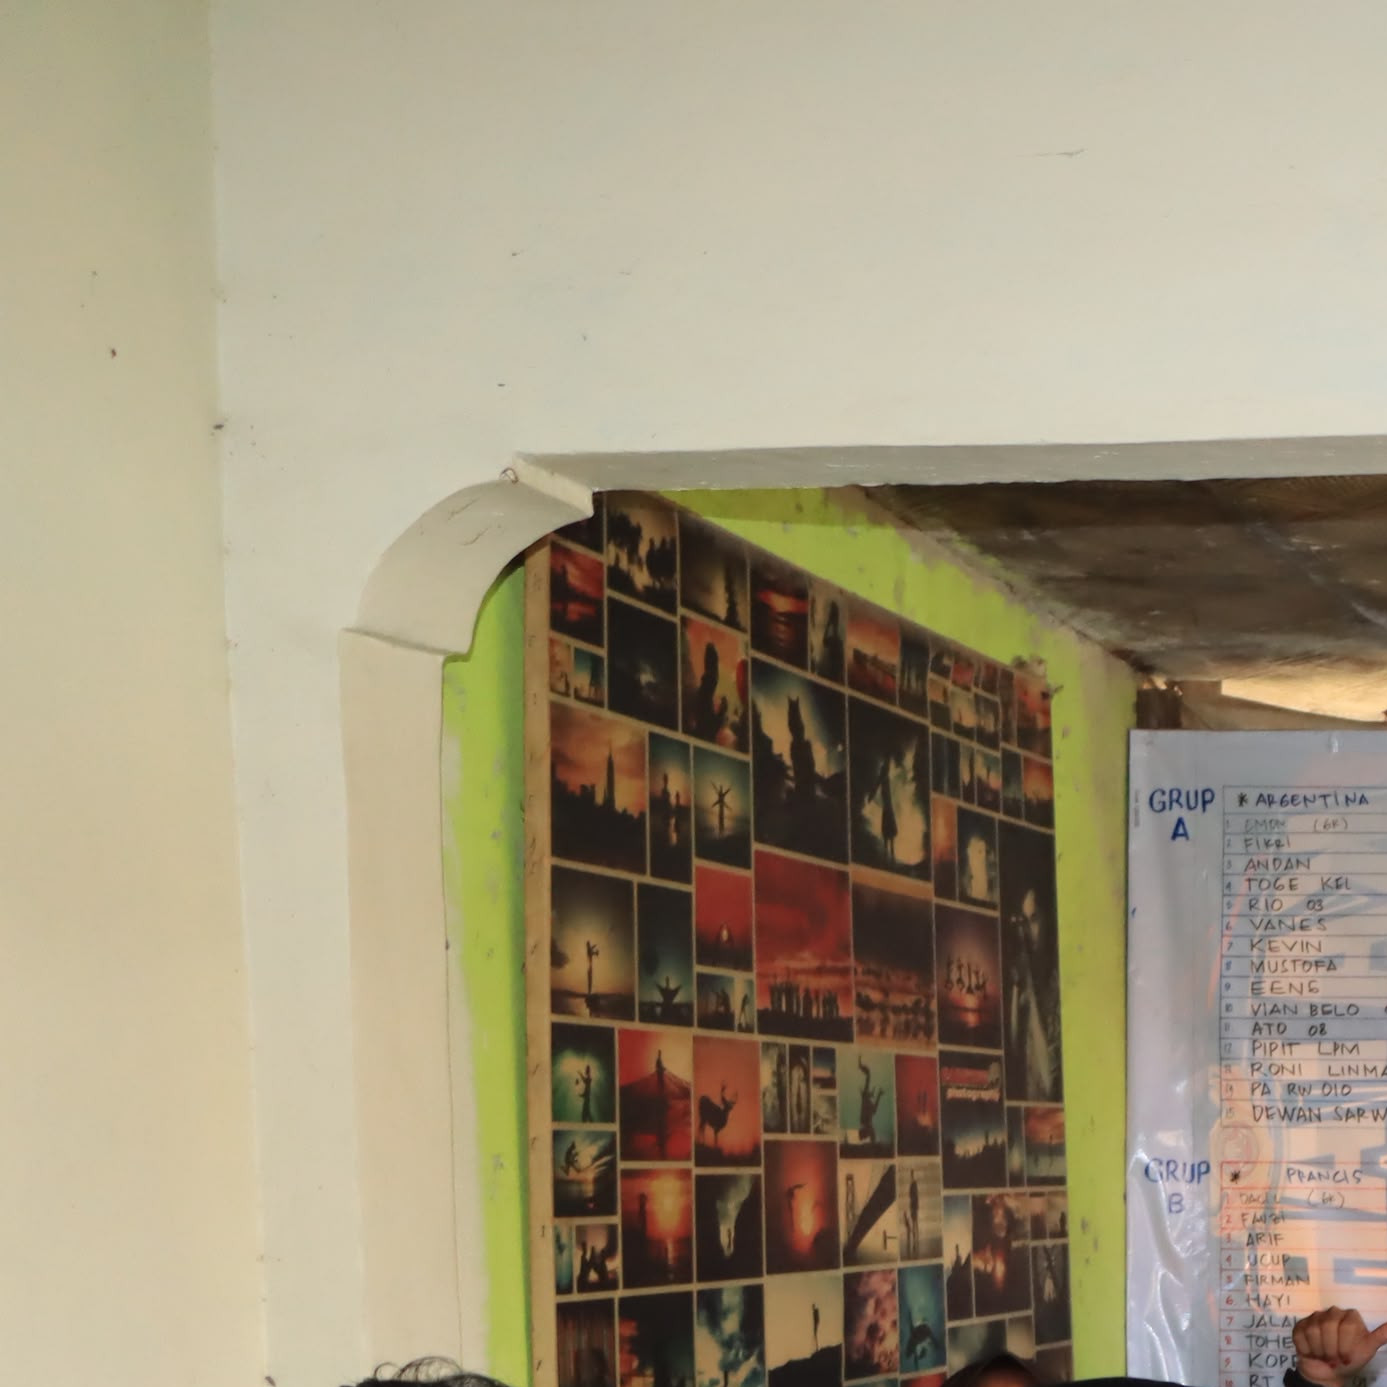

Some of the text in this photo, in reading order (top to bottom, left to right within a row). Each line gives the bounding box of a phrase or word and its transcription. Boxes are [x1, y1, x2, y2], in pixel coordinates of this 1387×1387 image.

[1148, 787, 1216, 813] GRUP
[1255, 790, 1370, 808] ARGENTINA
[1171, 816, 1190, 841] A
[1243, 835, 1291, 851] FIKRI
[1243, 857, 1311, 873] ANDAN
[1320, 876, 1353, 891] KEL
[1249, 898, 1325, 912] RIO 03
[1250, 917, 1328, 933] VANES
[1250, 939, 1323, 954] KEVIN
[1250, 958, 1339, 974] MUSTOFA
[1250, 1002, 1299, 1017] VIAN
[1309, 1003, 1361, 1017] BELO
[1250, 1020, 1328, 1037] ATO 08
[1250, 1040, 1302, 1059] PIPIT
[1250, 1062, 1303, 1078] RONI
[1250, 1081, 1353, 1097] PA RW 010
[1251, 1105, 1323, 1124] DEWAN
[1144, 1157, 1212, 1185] GRUP
[1167, 1192, 1186, 1215] B
[1245, 1232, 1285, 1247] ARIF
